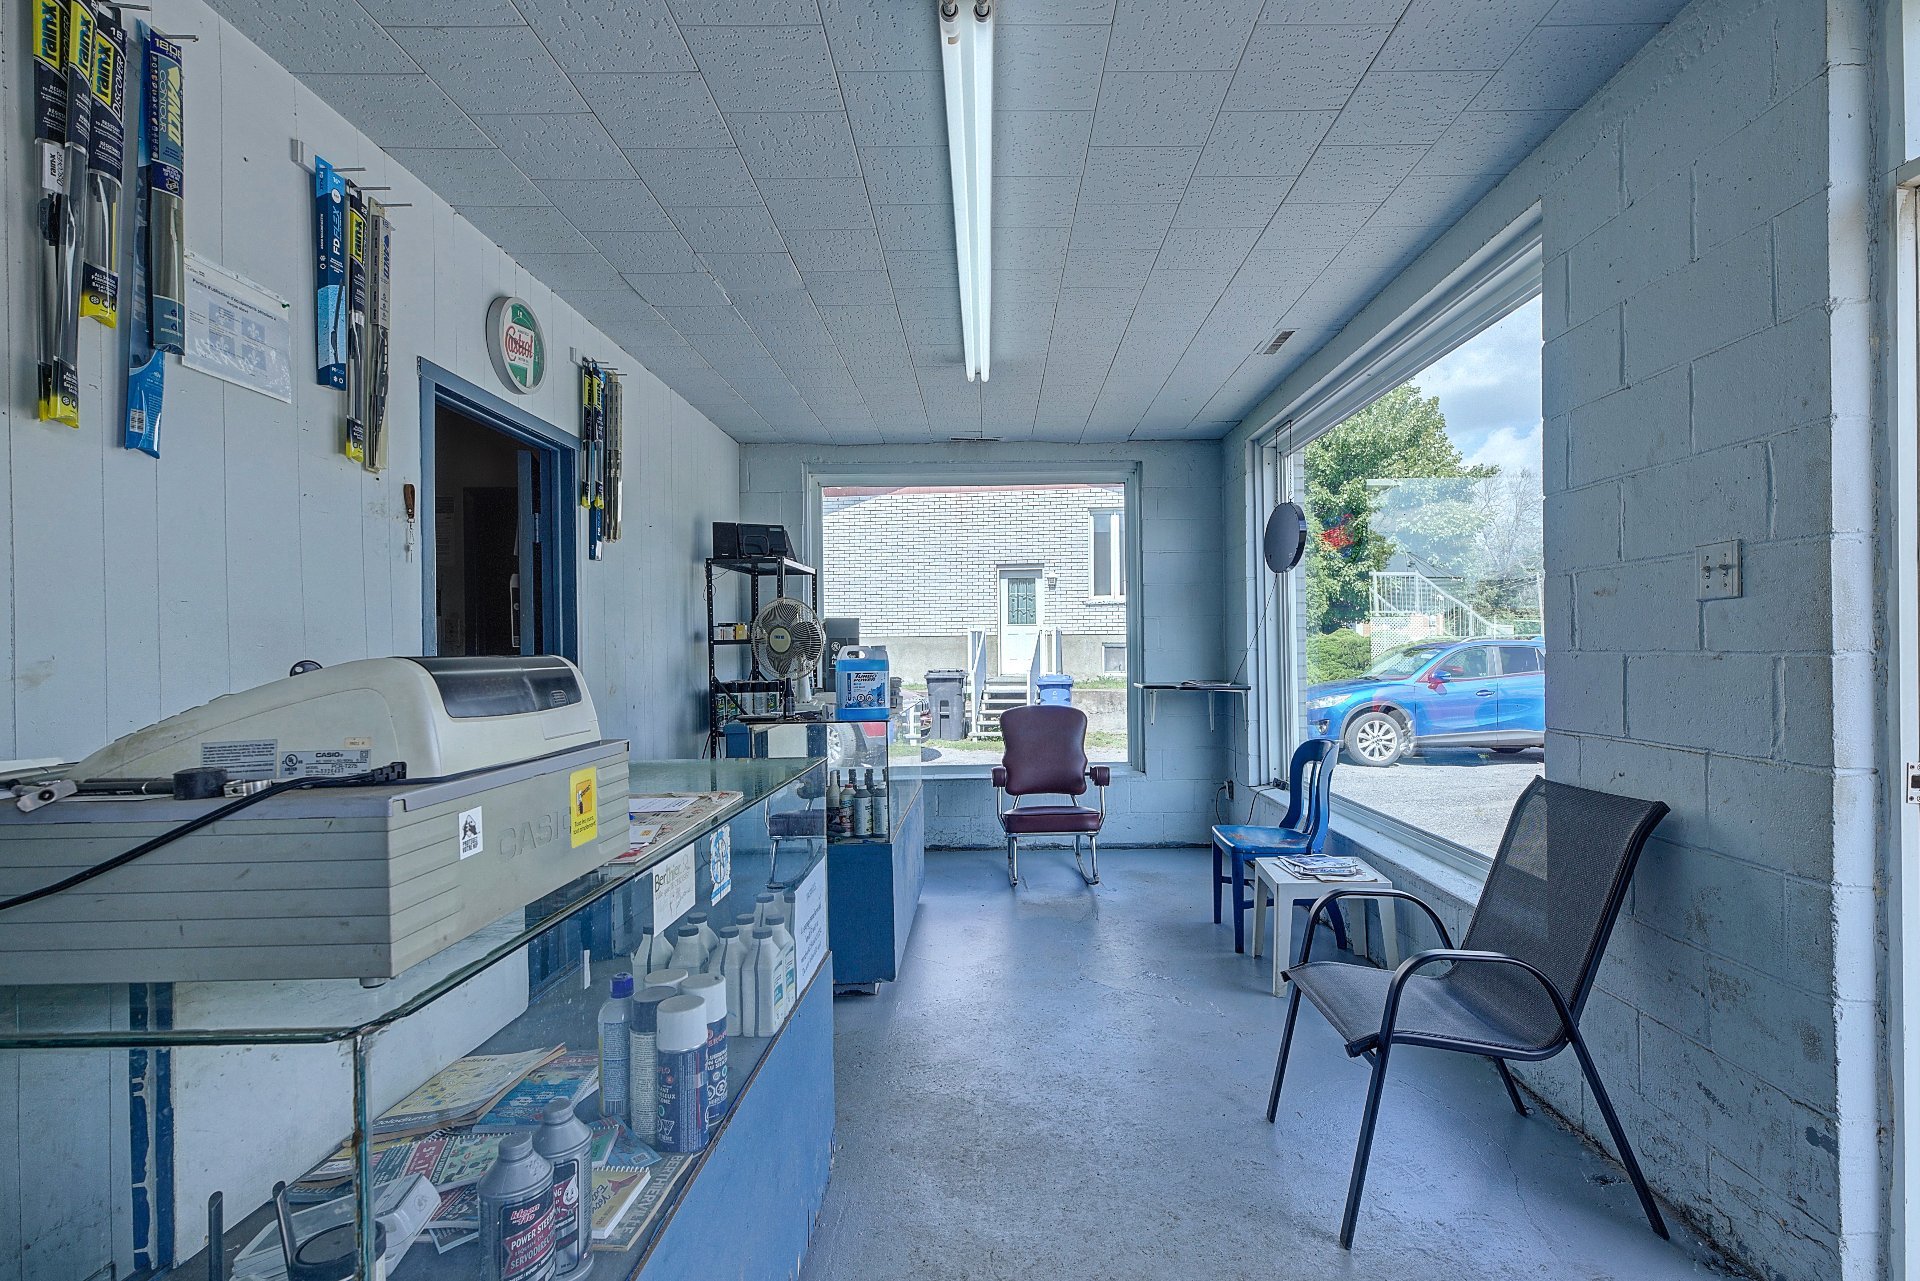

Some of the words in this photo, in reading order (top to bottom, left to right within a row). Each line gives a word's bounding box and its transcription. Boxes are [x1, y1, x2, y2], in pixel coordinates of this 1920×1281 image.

[159, 70, 167, 133] CONTOUR
[167, 79, 182, 147] ANCO
[505, 325, 534, 361] Castrol
[622, 1155, 685, 1234] BERTHIERVILLE
[511, 1229, 536, 1251] POWER
